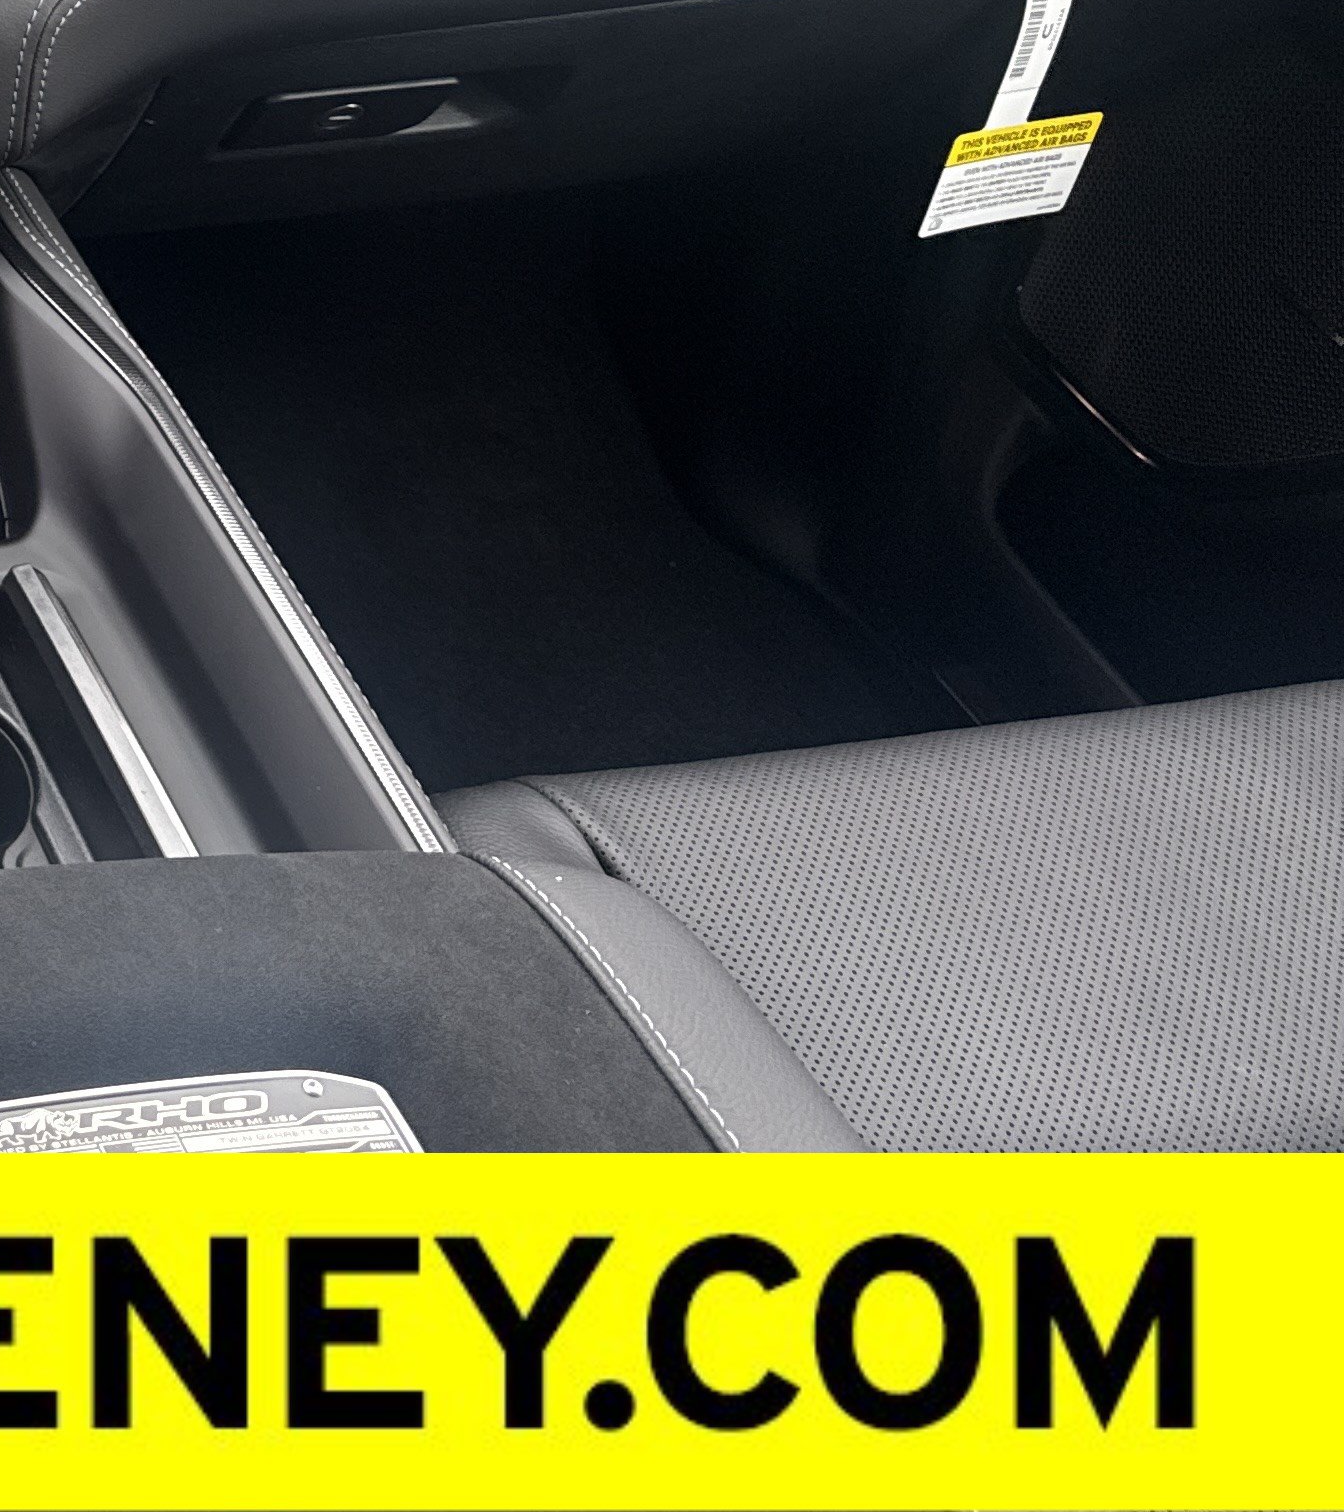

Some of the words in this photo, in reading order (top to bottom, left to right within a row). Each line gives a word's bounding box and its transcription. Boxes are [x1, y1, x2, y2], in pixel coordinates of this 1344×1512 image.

[956, 150, 982, 163] WITH
[982, 140, 1039, 157] ADVANCED
[1039, 136, 1059, 147] AIR
[1060, 132, 1088, 144] BAGS
[961, 137, 983, 150] THIS
[985, 129, 1028, 145] VEHICLE
[1029, 127, 1040, 138] IS
[1041, 120, 1093, 137] EQUIPPED
[64, 1089, 269, 1134] RHO
[51, 1131, 134, 1148] STELLANTIS
[146, 1123, 203, 1137] AUBURN
[206, 1118, 244, 1130] HILLS
[270, 1113, 299, 1124] USA
